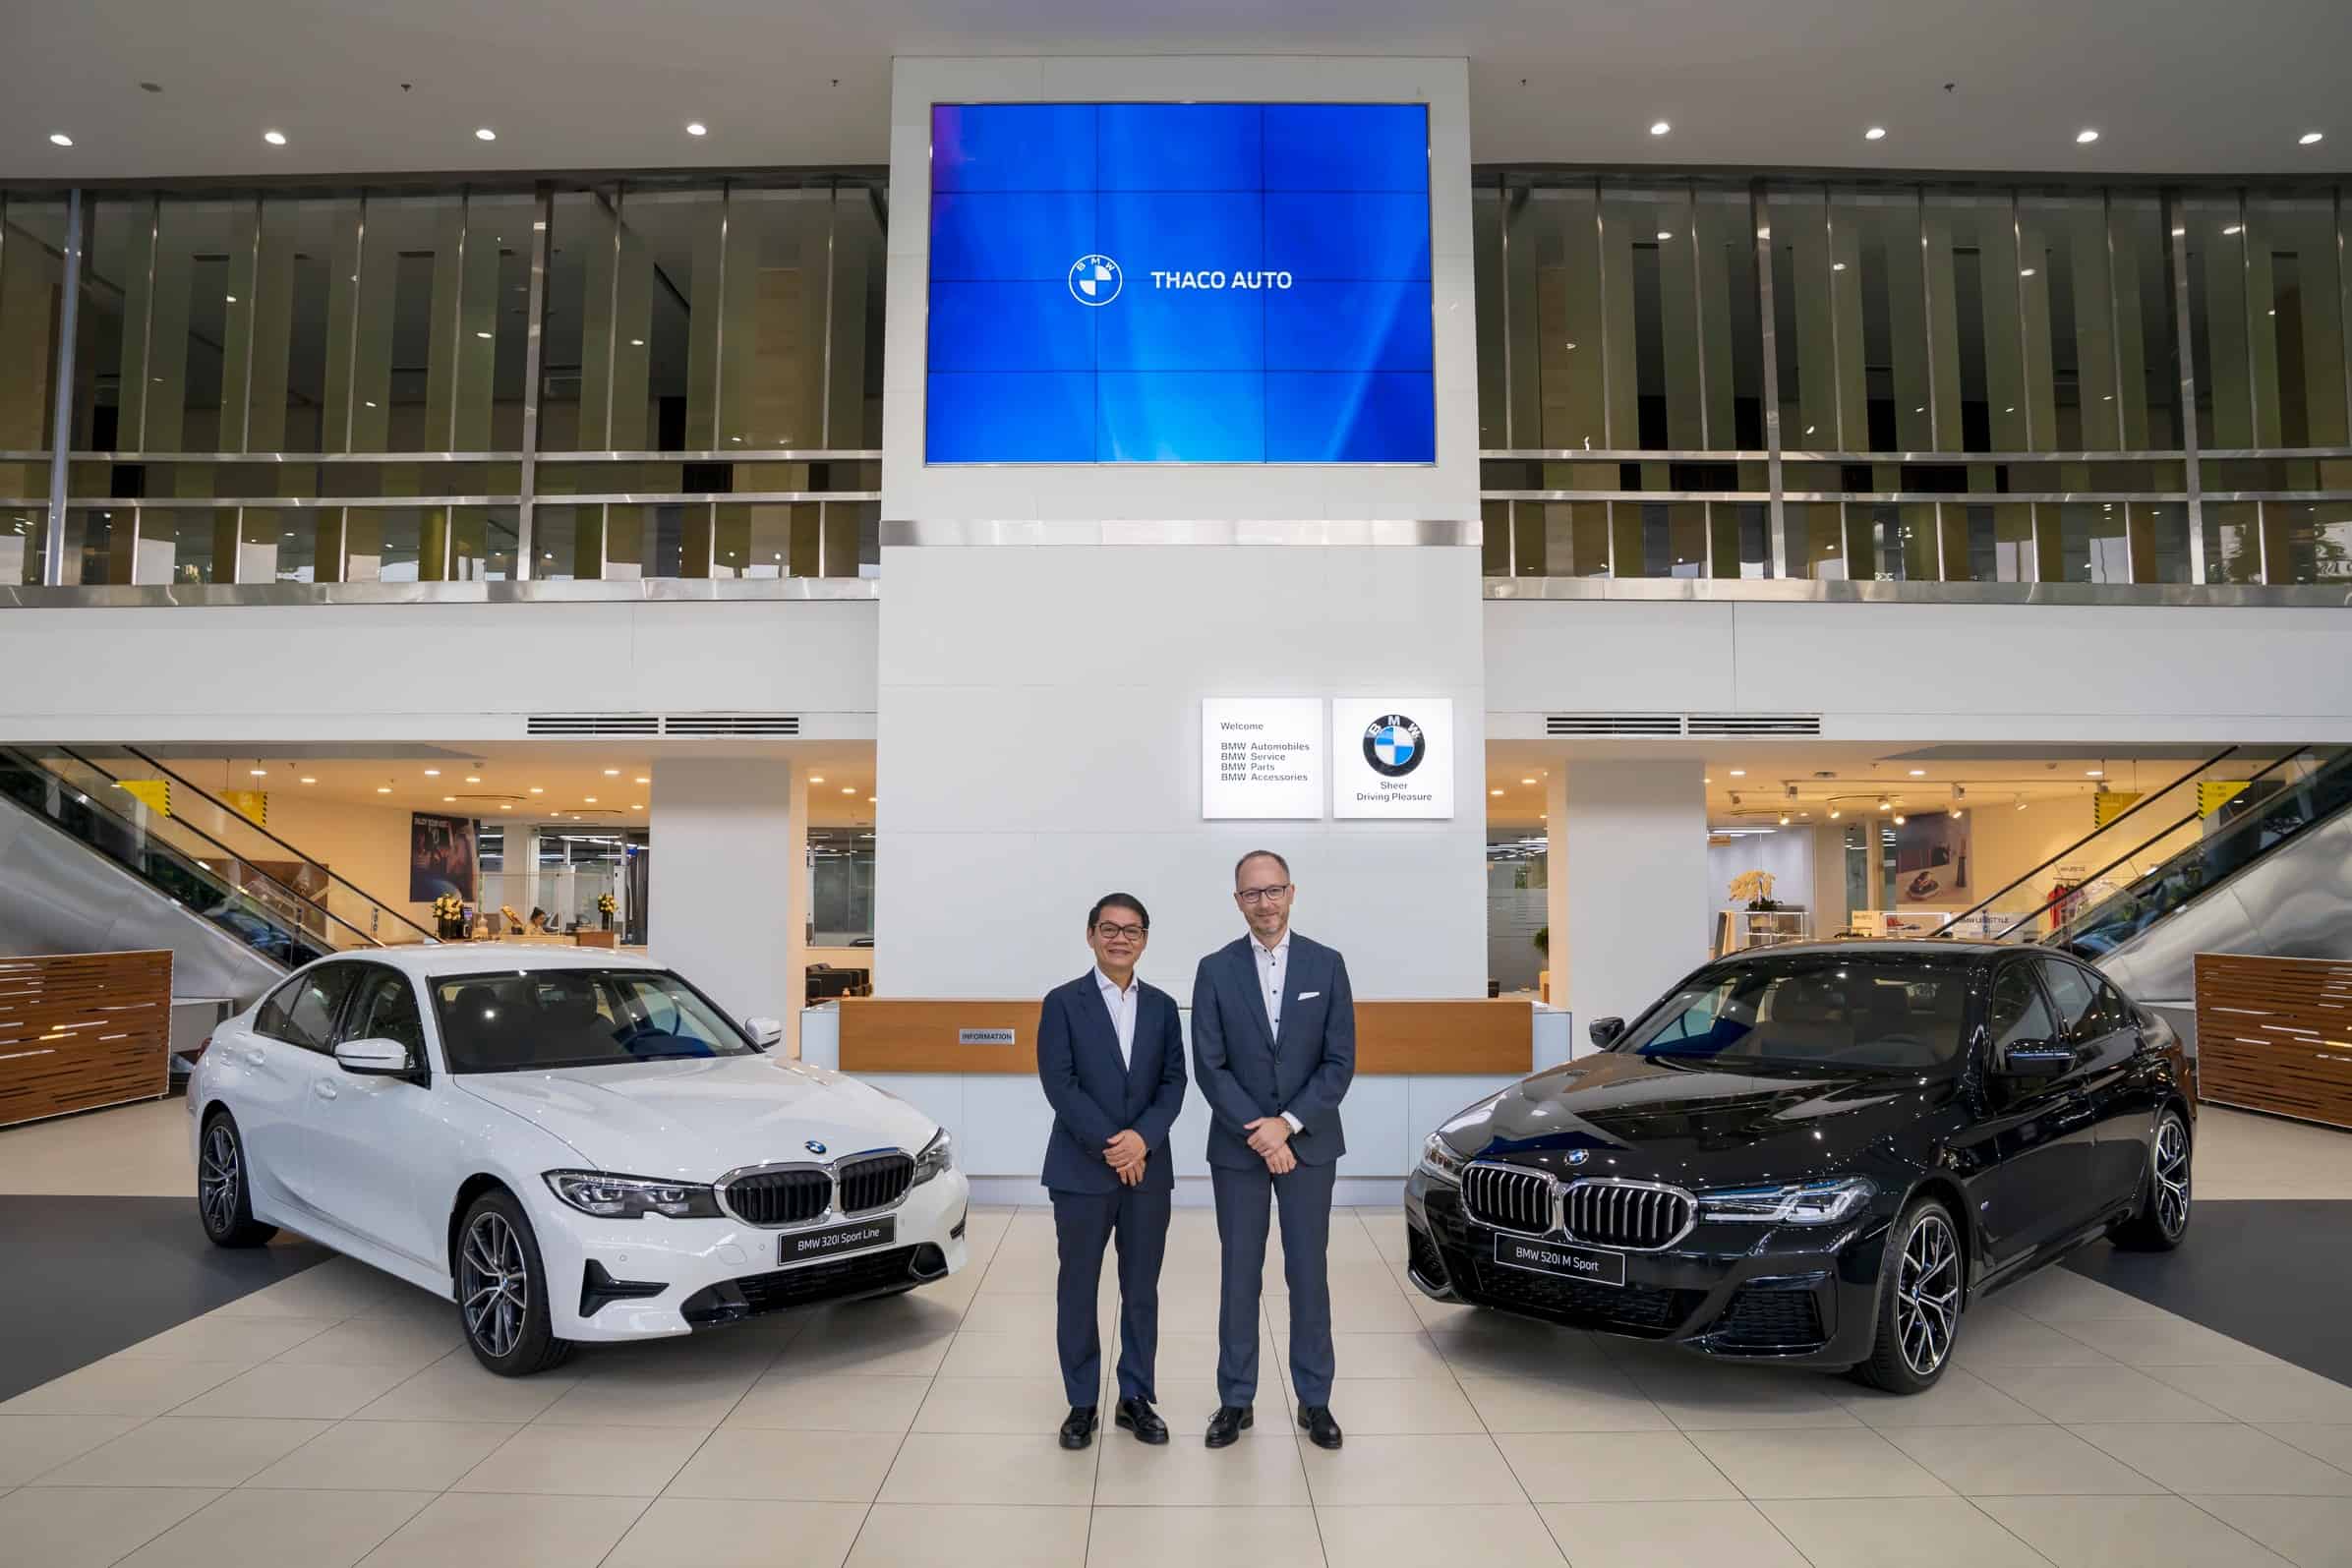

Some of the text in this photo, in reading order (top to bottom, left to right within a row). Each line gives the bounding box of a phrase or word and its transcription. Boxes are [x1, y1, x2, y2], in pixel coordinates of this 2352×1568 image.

[1150, 271, 1292, 289] THACO AUTO
[1220, 722, 1264, 731] Welcome
[1368, 715, 1421, 738] BMW
[1220, 742, 1310, 751] BMW Automobiles
[1220, 752, 1286, 761] BMW Service
[1220, 773, 1308, 782] BMW Accessories
[1380, 782, 1408, 790] Sheer
[1356, 792, 1432, 802] Driving Pleasure
[962, 1031, 1013, 1040] INFORMATION
[797, 1228, 880, 1250] BMW 320i Sport Line
[1515, 1246, 1600, 1272] BMW 520i M Sport
